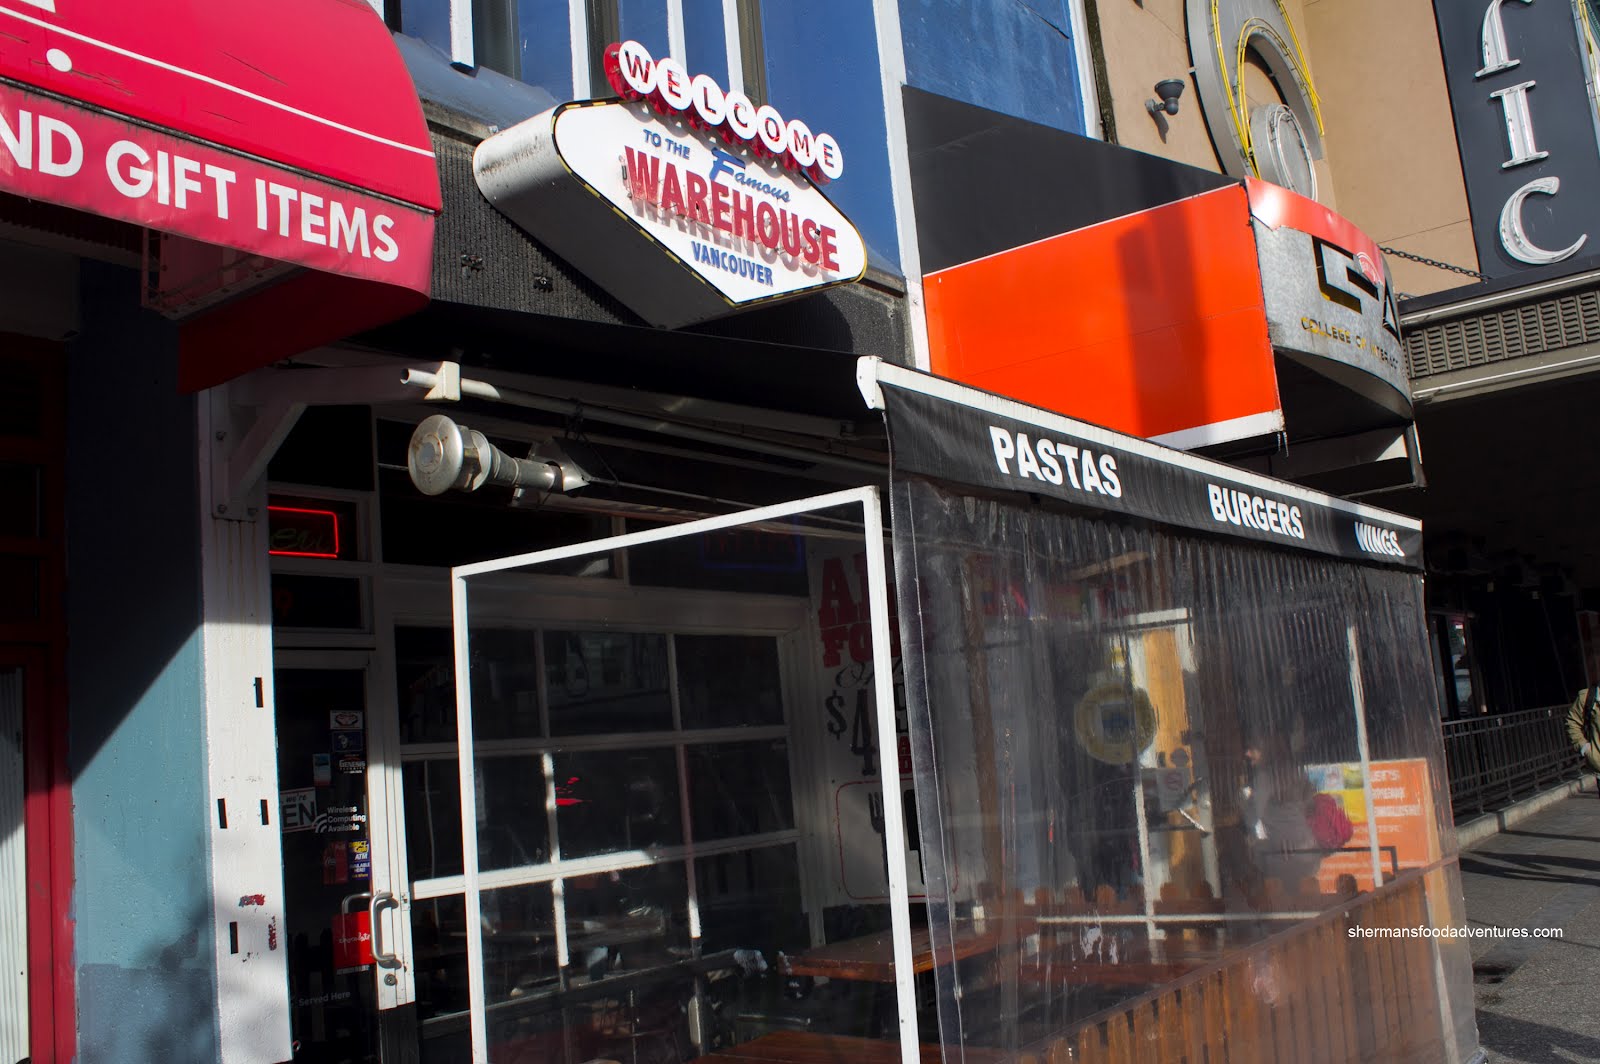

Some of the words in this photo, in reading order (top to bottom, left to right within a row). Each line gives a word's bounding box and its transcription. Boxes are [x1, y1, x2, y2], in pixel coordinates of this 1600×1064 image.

[622, 46, 840, 173] WELCOME
[643, 129, 662, 147] TO
[665, 138, 690, 160] THE
[709, 146, 791, 203] Famous
[105, 139, 236, 219] GIFT
[255, 178, 400, 263] ITEMS
[624, 145, 840, 272] WAREHOUSE
[691, 241, 774, 287] VANCOUVER
[1301, 317, 1351, 345] COLLEGE
[989, 426, 1122, 498] PASTAS
[1207, 483, 1304, 540] BURGERS
[1354, 522, 1405, 557] WINGS
[327, 805, 358, 814] Wireless
[327, 814, 366, 824] Computing
[327, 823, 360, 833] Available
